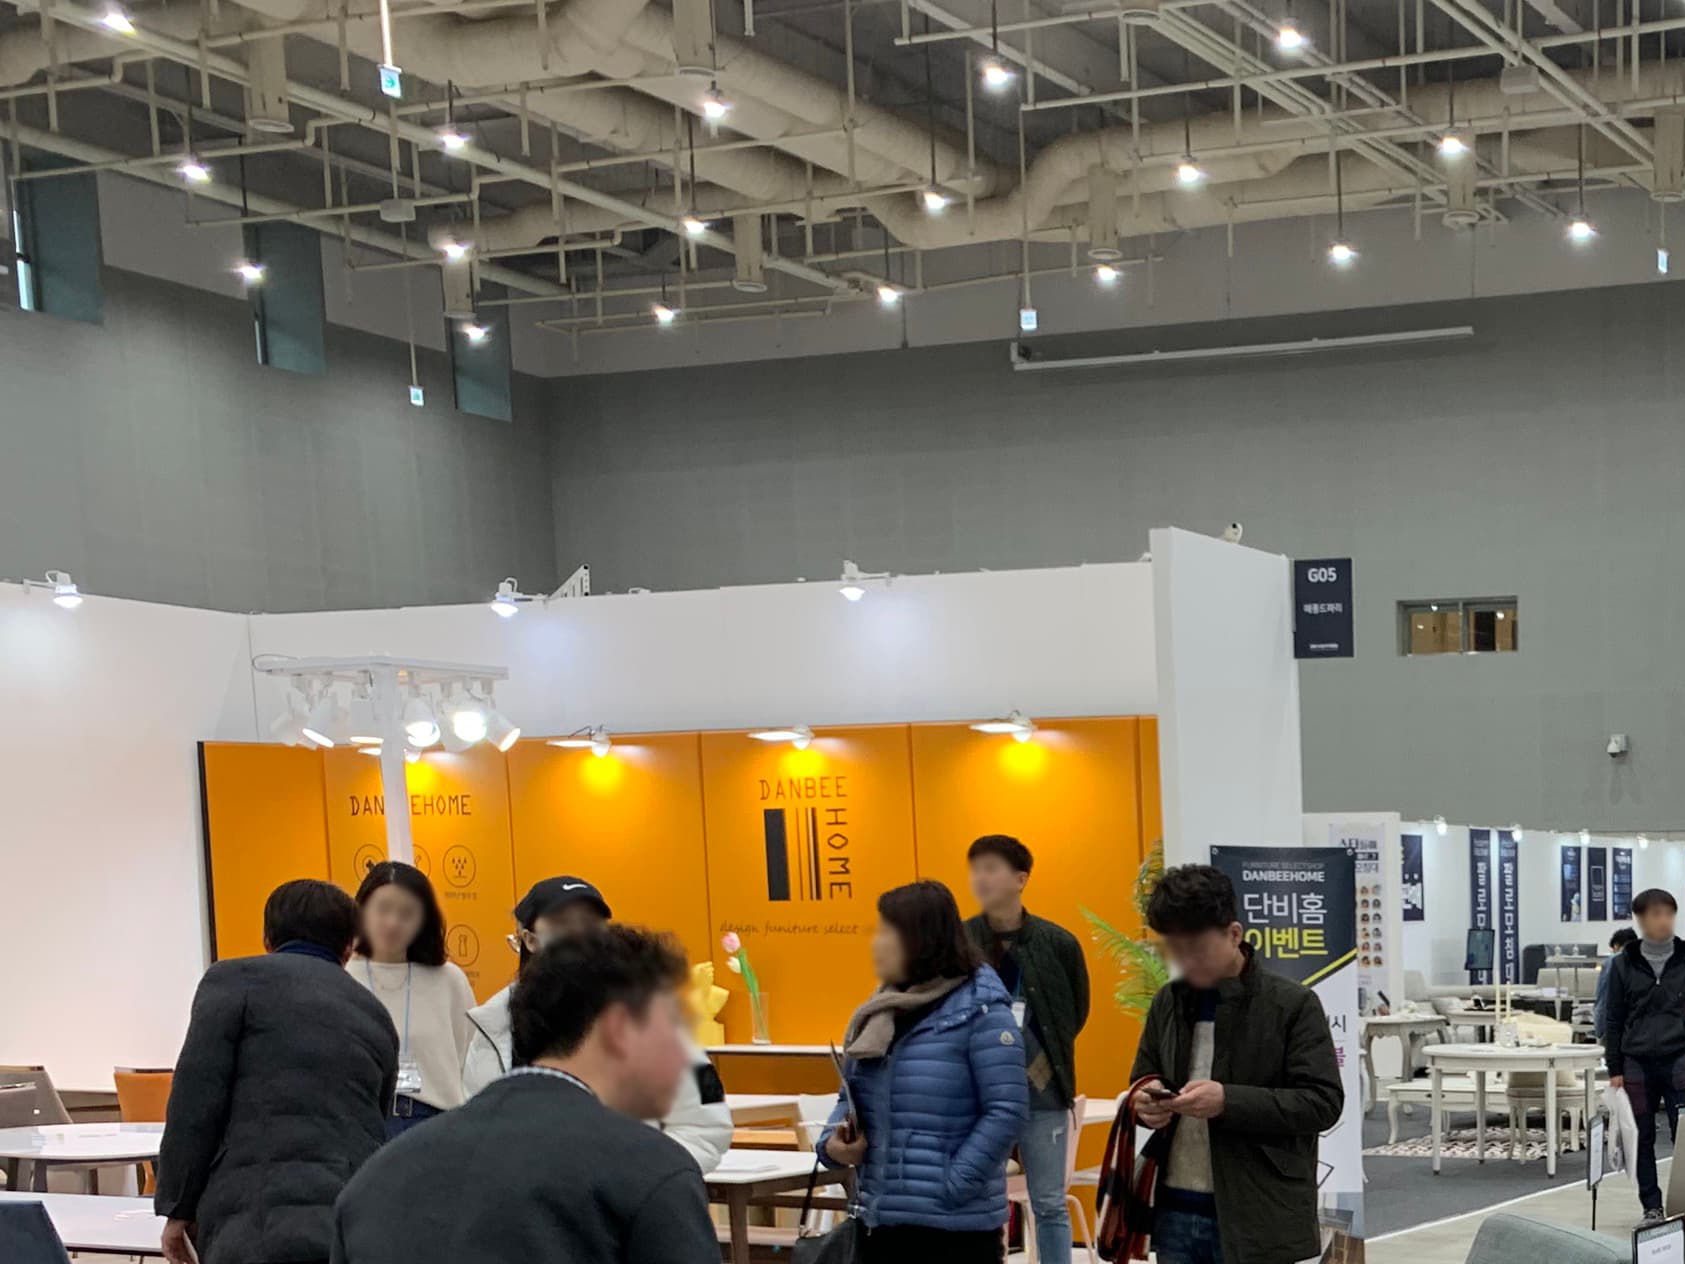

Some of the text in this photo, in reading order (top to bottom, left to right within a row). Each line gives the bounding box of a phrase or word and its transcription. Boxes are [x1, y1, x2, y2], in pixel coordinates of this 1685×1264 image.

[1308, 567, 1337, 583] G05
[759, 776, 848, 801] DANBEE
[350, 795, 473, 816] DANEHOME
[825, 808, 853, 900] HOME
[1242, 871, 1325, 882] DANBEEHOME
[1243, 892, 1328, 925] 단비홈
[1244, 927, 1329, 959] 이벤트
